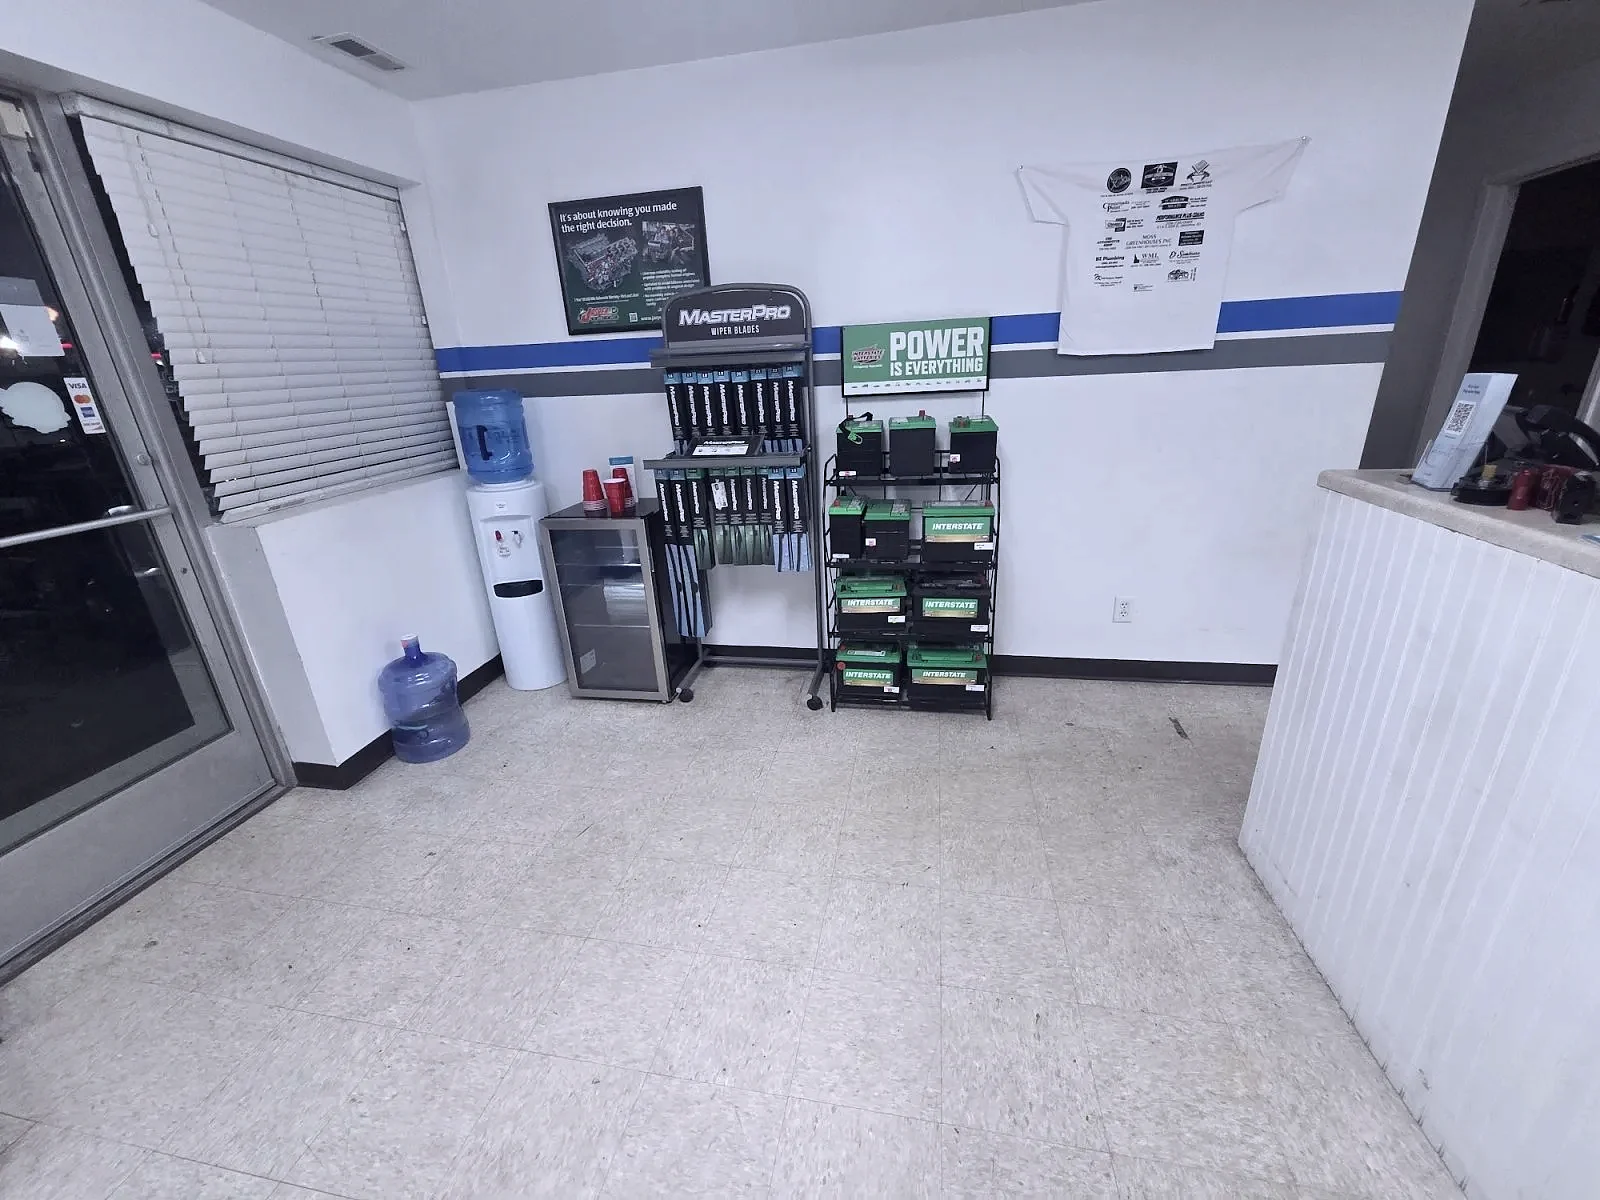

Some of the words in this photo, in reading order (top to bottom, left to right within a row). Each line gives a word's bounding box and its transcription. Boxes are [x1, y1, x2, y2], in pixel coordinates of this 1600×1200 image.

[560, 211, 572, 223] It's
[572, 209, 597, 221] about
[598, 206, 634, 220] knowing
[634, 204, 651, 217] you
[652, 200, 677, 212] made
[562, 222, 574, 233] the
[576, 220, 596, 234] right
[596, 217, 632, 230] decision.
[711, 326, 732, 336] WIPER
[734, 324, 760, 334] BLADES
[890, 326, 984, 361] POWER
[890, 362, 902, 376] IS
[906, 358, 983, 376] EVERYTHING
